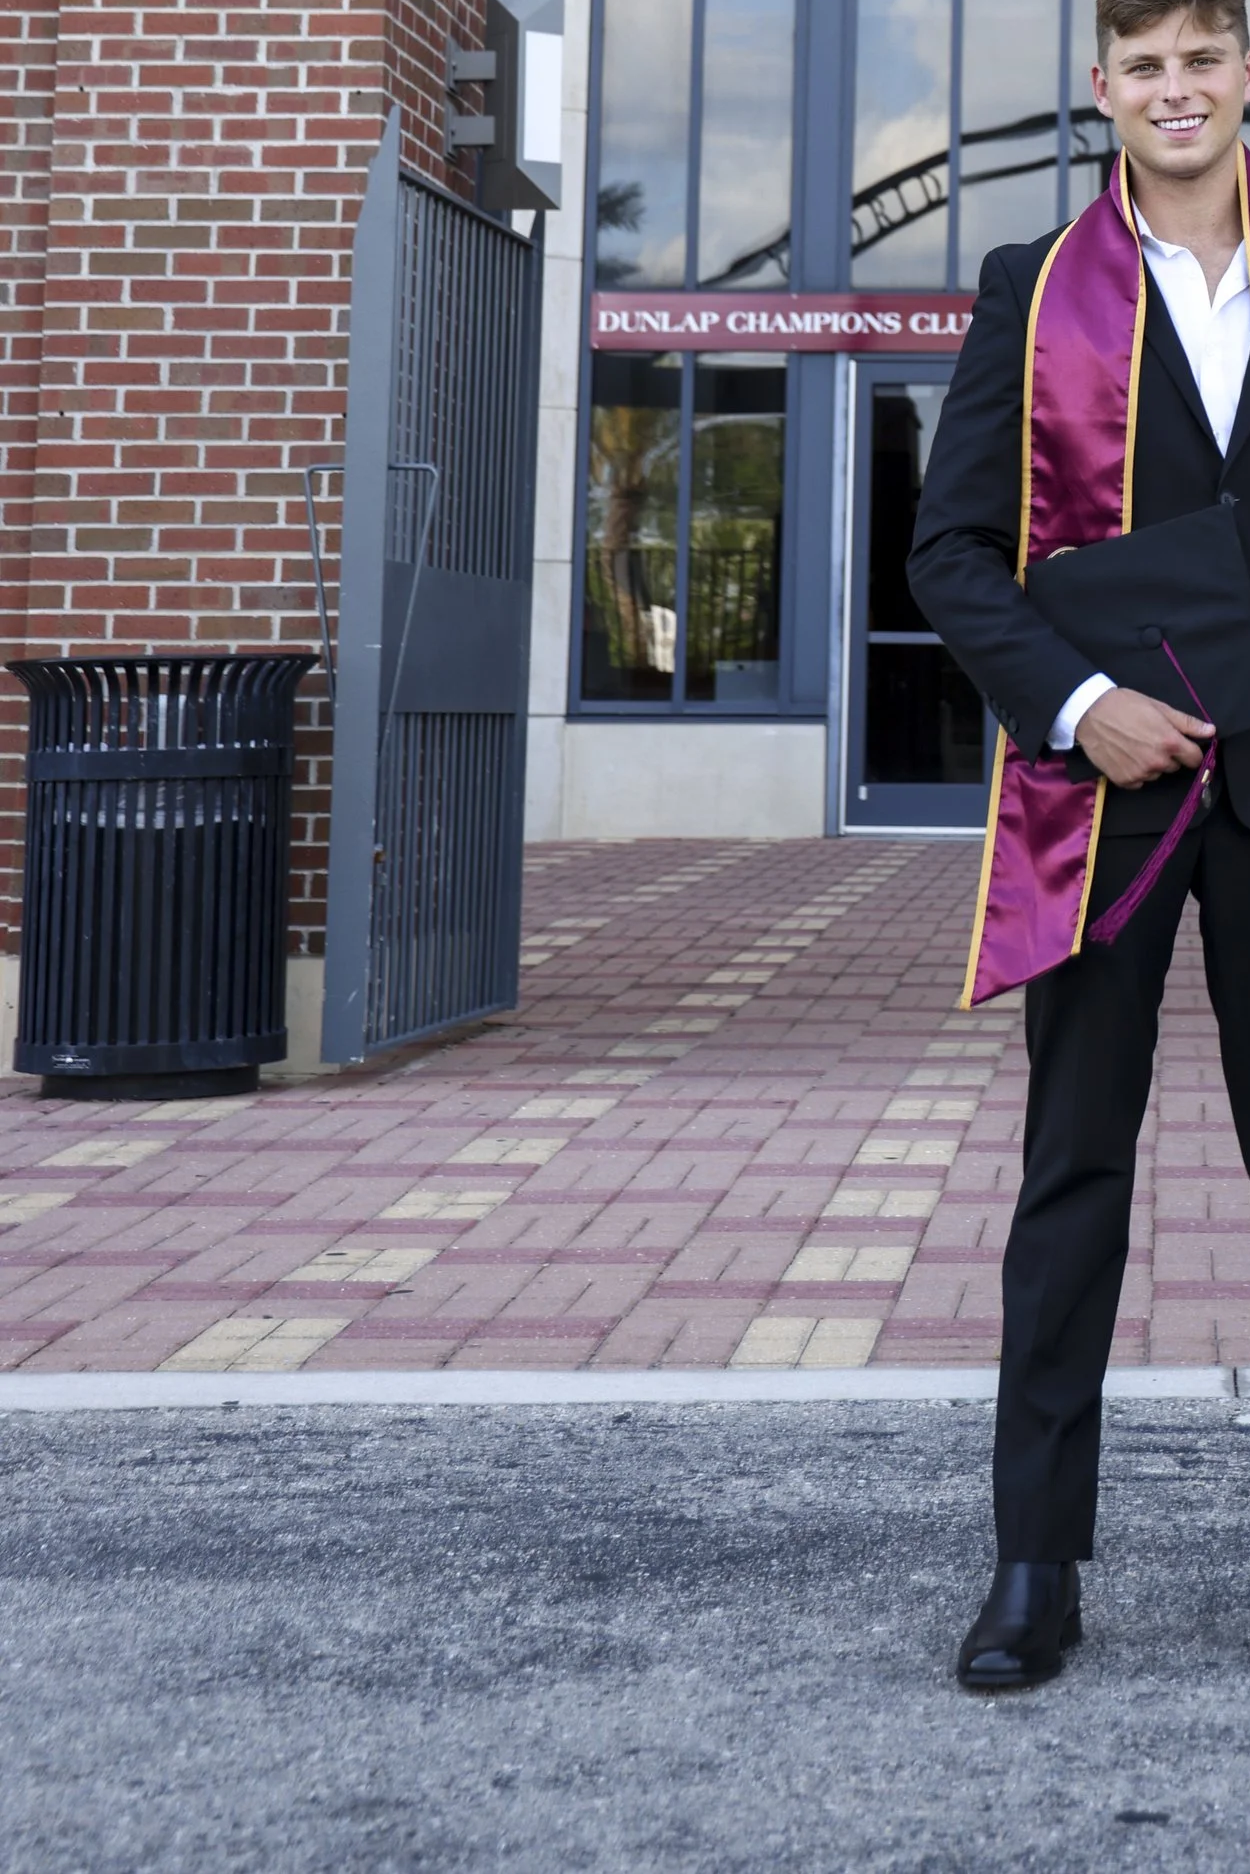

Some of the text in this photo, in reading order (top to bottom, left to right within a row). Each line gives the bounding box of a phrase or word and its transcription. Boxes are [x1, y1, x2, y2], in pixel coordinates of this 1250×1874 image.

[599, 310, 973, 336] DUNLAP CHAMPIONS CLU
